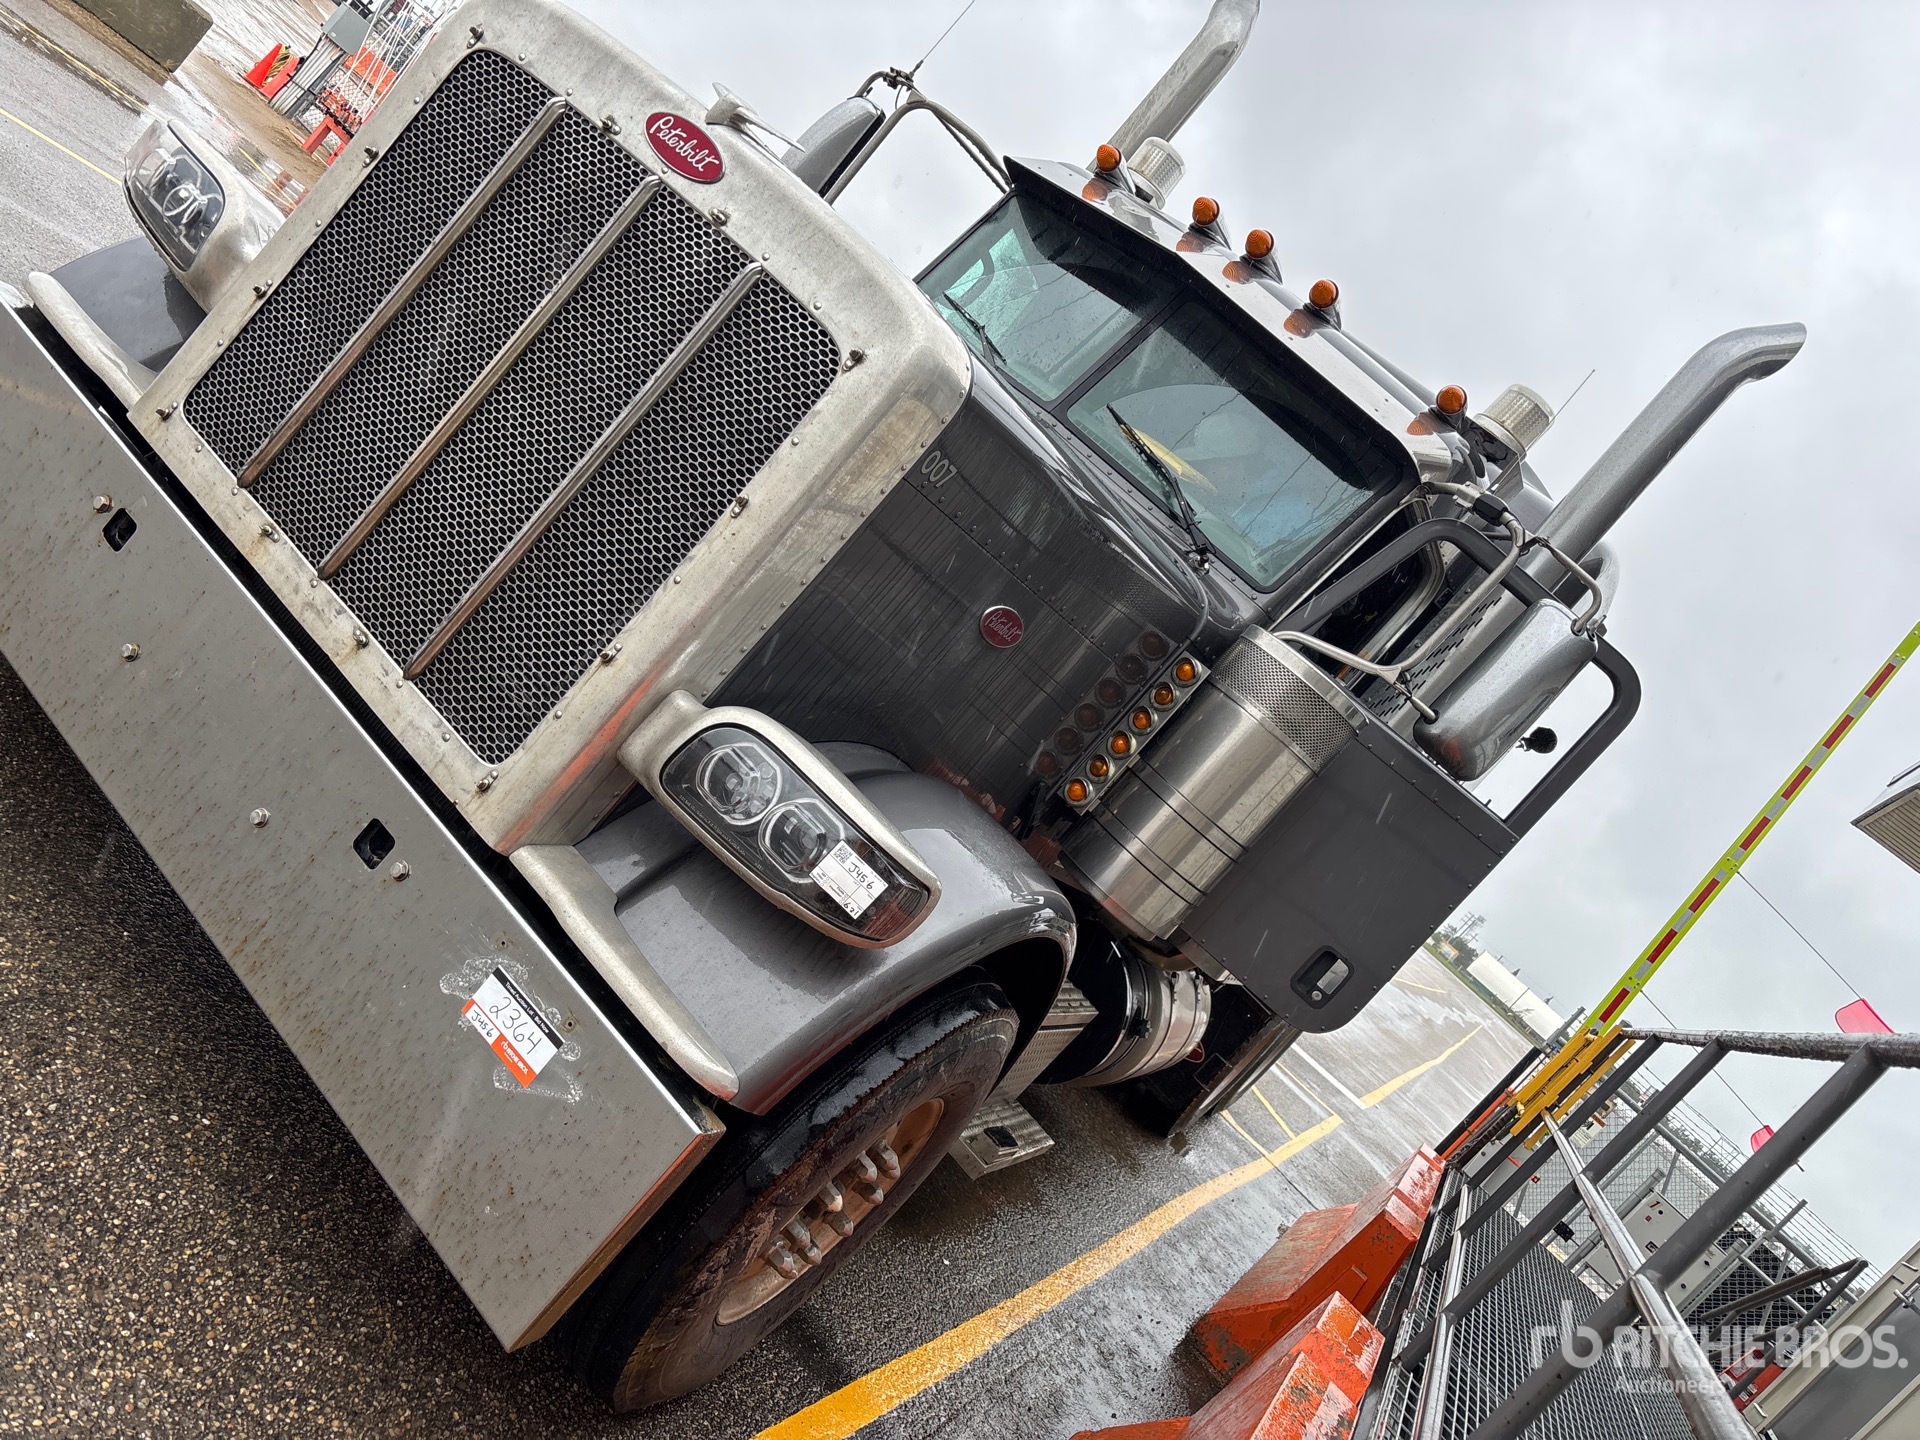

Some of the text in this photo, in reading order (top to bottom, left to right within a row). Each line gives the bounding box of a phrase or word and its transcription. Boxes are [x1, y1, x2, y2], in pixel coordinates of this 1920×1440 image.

[649, 115, 720, 172] Peterbilt
[920, 450, 958, 488] 007
[984, 610, 1022, 641] Peterbilt
[489, 996, 543, 1055] 2364
